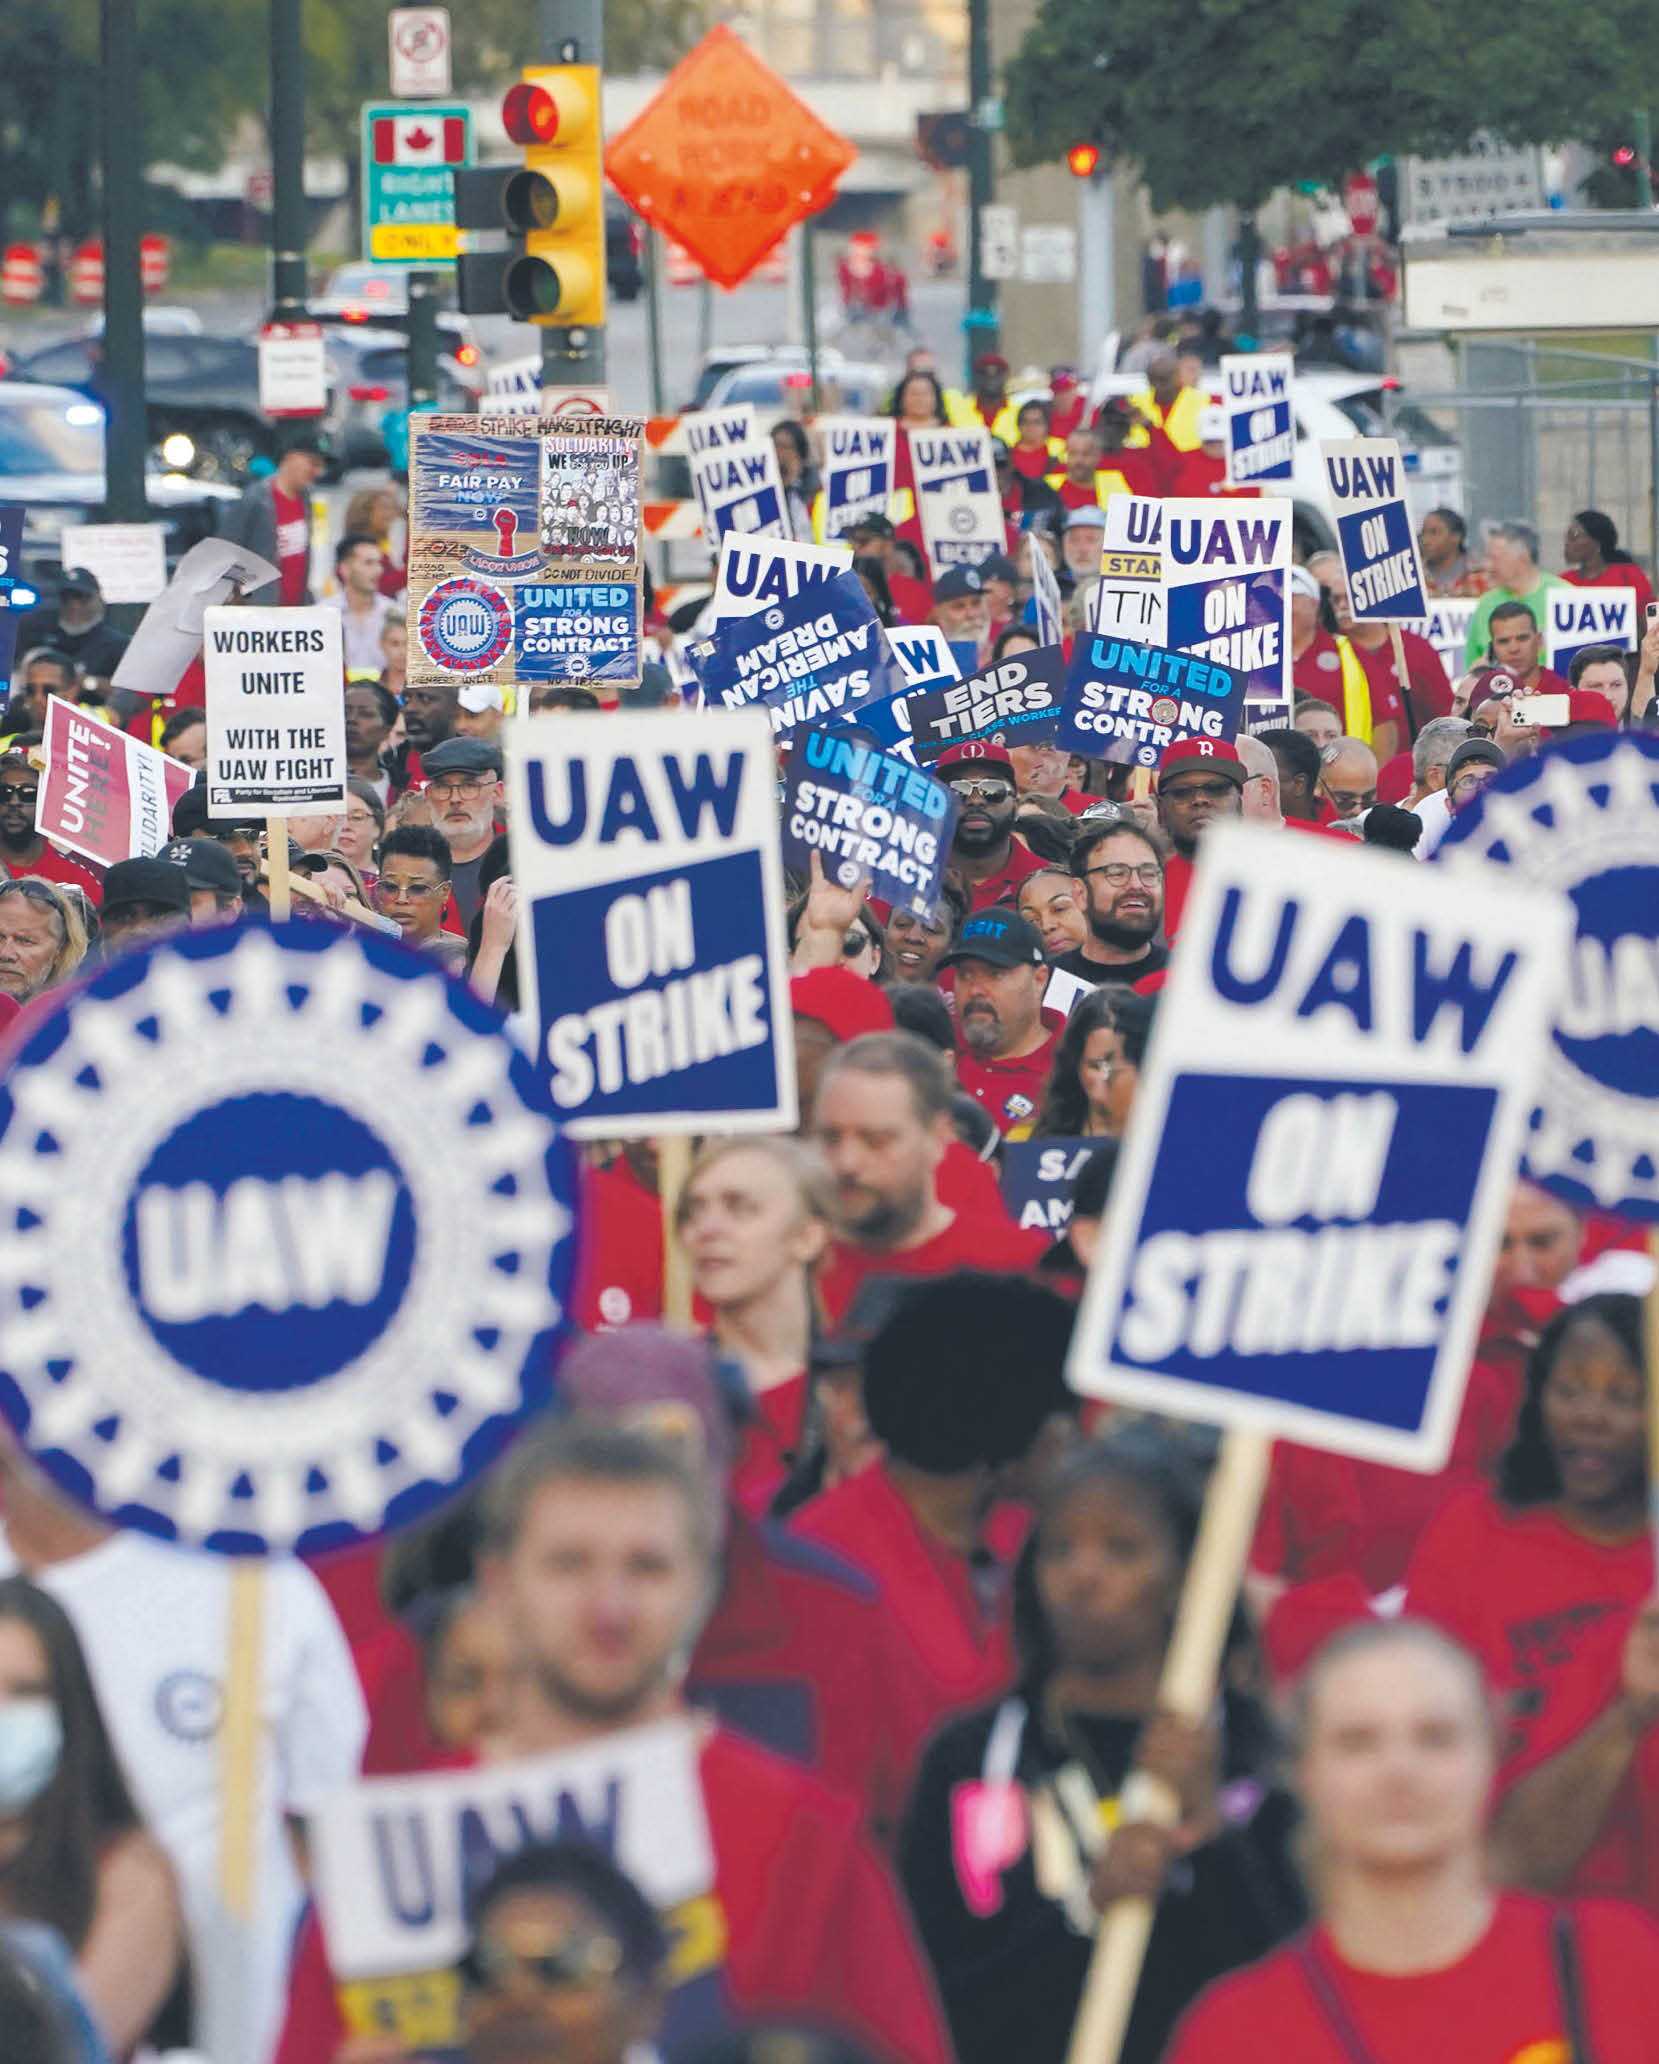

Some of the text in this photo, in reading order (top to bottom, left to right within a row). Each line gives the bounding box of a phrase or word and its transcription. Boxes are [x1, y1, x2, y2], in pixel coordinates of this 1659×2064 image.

[1229, 370, 1287, 397] UAW
[545, 437, 632, 453] SOLIDARITY
[688, 418, 747, 454] UAW
[831, 430, 888, 456] UAW
[916, 440, 982, 467] UAW
[439, 474, 523, 489] FAIR PAY
[549, 454, 567, 469] WE
[613, 454, 629, 469] UP
[705, 453, 766, 491] UAW
[1327, 456, 1396, 498] UAW
[1127, 502, 1162, 544] UA
[1170, 519, 1282, 565] UAW
[1360, 513, 1389, 560] ON
[524, 587, 630, 608] UNITED
[1351, 551, 1418, 612] STRIKE
[446, 614, 486, 637] UAW
[524, 617, 630, 636] STRONG
[1204, 582, 1247, 635] ON
[1554, 603, 1628, 634] UAW
[213, 629, 325, 653] WORKERS
[522, 637, 632, 653] CONTRACT
[736, 612, 839, 678] DREAM
[242, 672, 305, 695] UNITE
[721, 623, 869, 712] AMERICAN
[786, 674, 819, 700] THE
[945, 662, 1028, 715] END
[1091, 639, 1233, 698] UNITED
[1140, 680, 1182, 698] FOR A
[769, 669, 871, 733] SAVIN
[930, 681, 1053, 739] TIERS
[226, 727, 326, 750] WITH THE
[60, 719, 91, 833] UNITE
[219, 757, 335, 781] UAW FIGHT
[806, 731, 948, 819] UNITED
[137, 752, 161, 858] LIDARITY!
[527, 752, 746, 848] UAW
[795, 781, 938, 865] STRONG
[790, 813, 934, 892] CONTRACT
[604, 877, 697, 990] ON
[1211, 886, 1519, 1054] UAW
[1558, 932, 1659, 1041] UA
[546, 953, 769, 1110] STRIKE
[1246, 1090, 1401, 1228] ON
[134, 1168, 397, 1325] UAW
[1116, 1217, 1468, 1364] STRIKE
